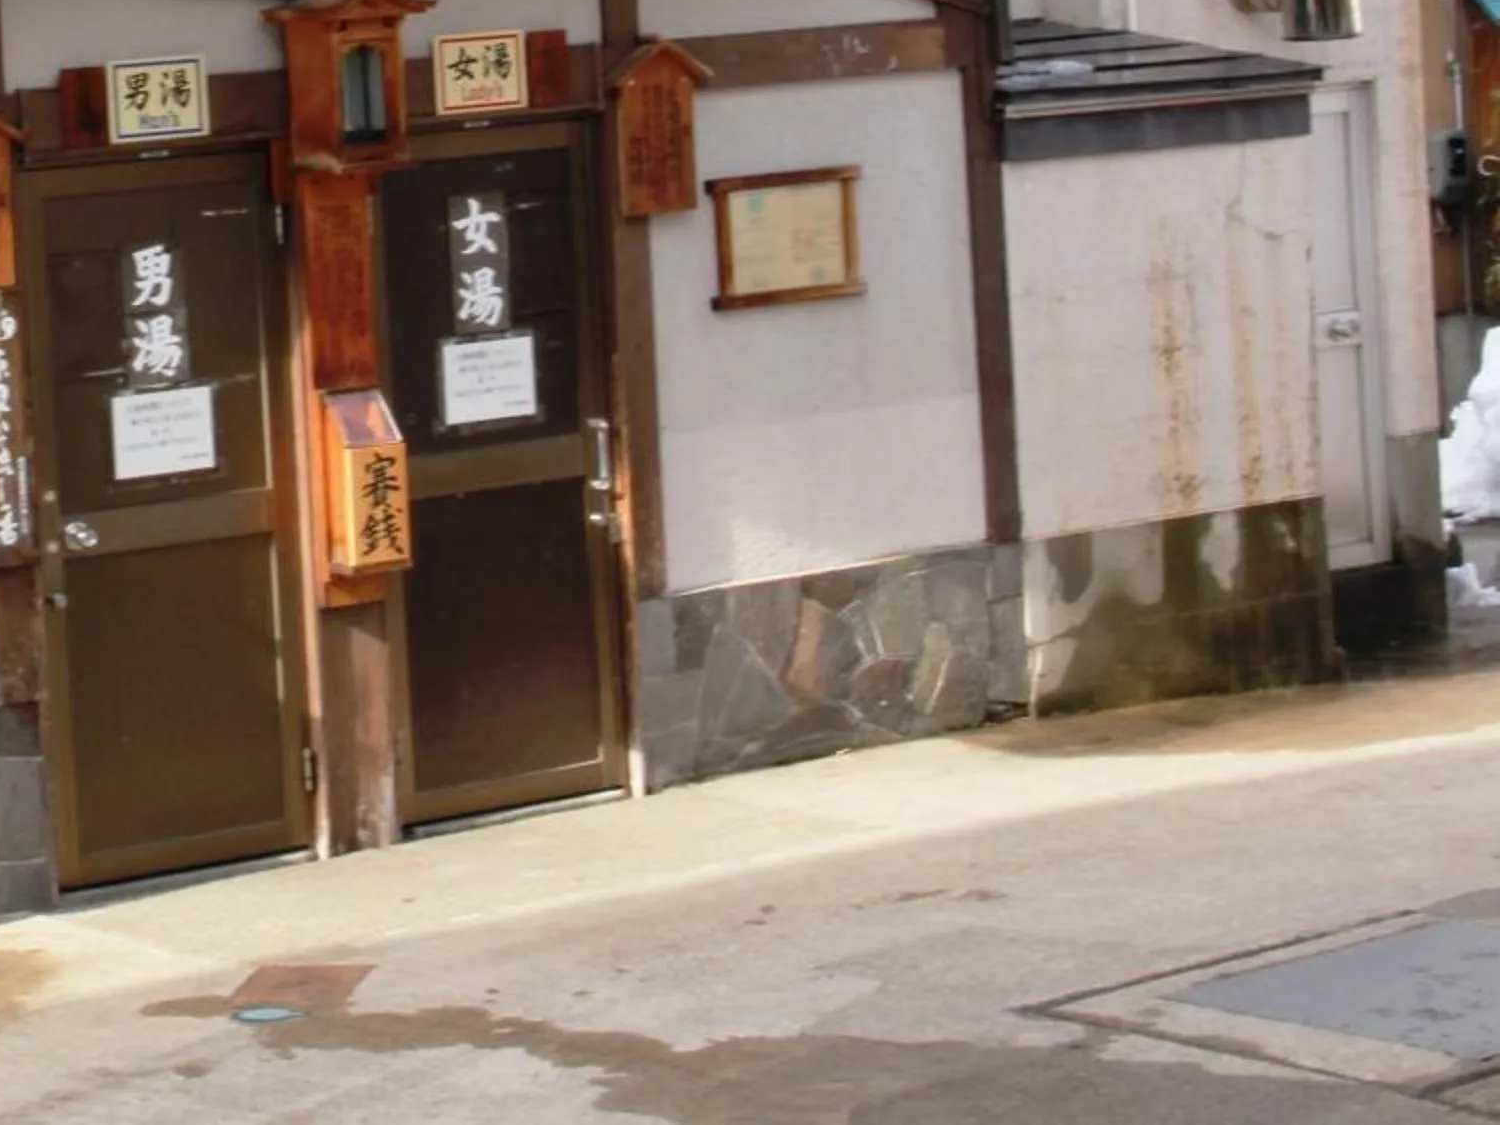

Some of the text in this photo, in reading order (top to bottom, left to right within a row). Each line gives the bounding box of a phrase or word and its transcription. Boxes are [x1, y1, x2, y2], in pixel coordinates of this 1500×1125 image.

[124, 69, 192, 111] 男湯
[446, 42, 512, 81] 女湯
[452, 198, 503, 326] 女湯
[132, 244, 183, 377] 男湯
